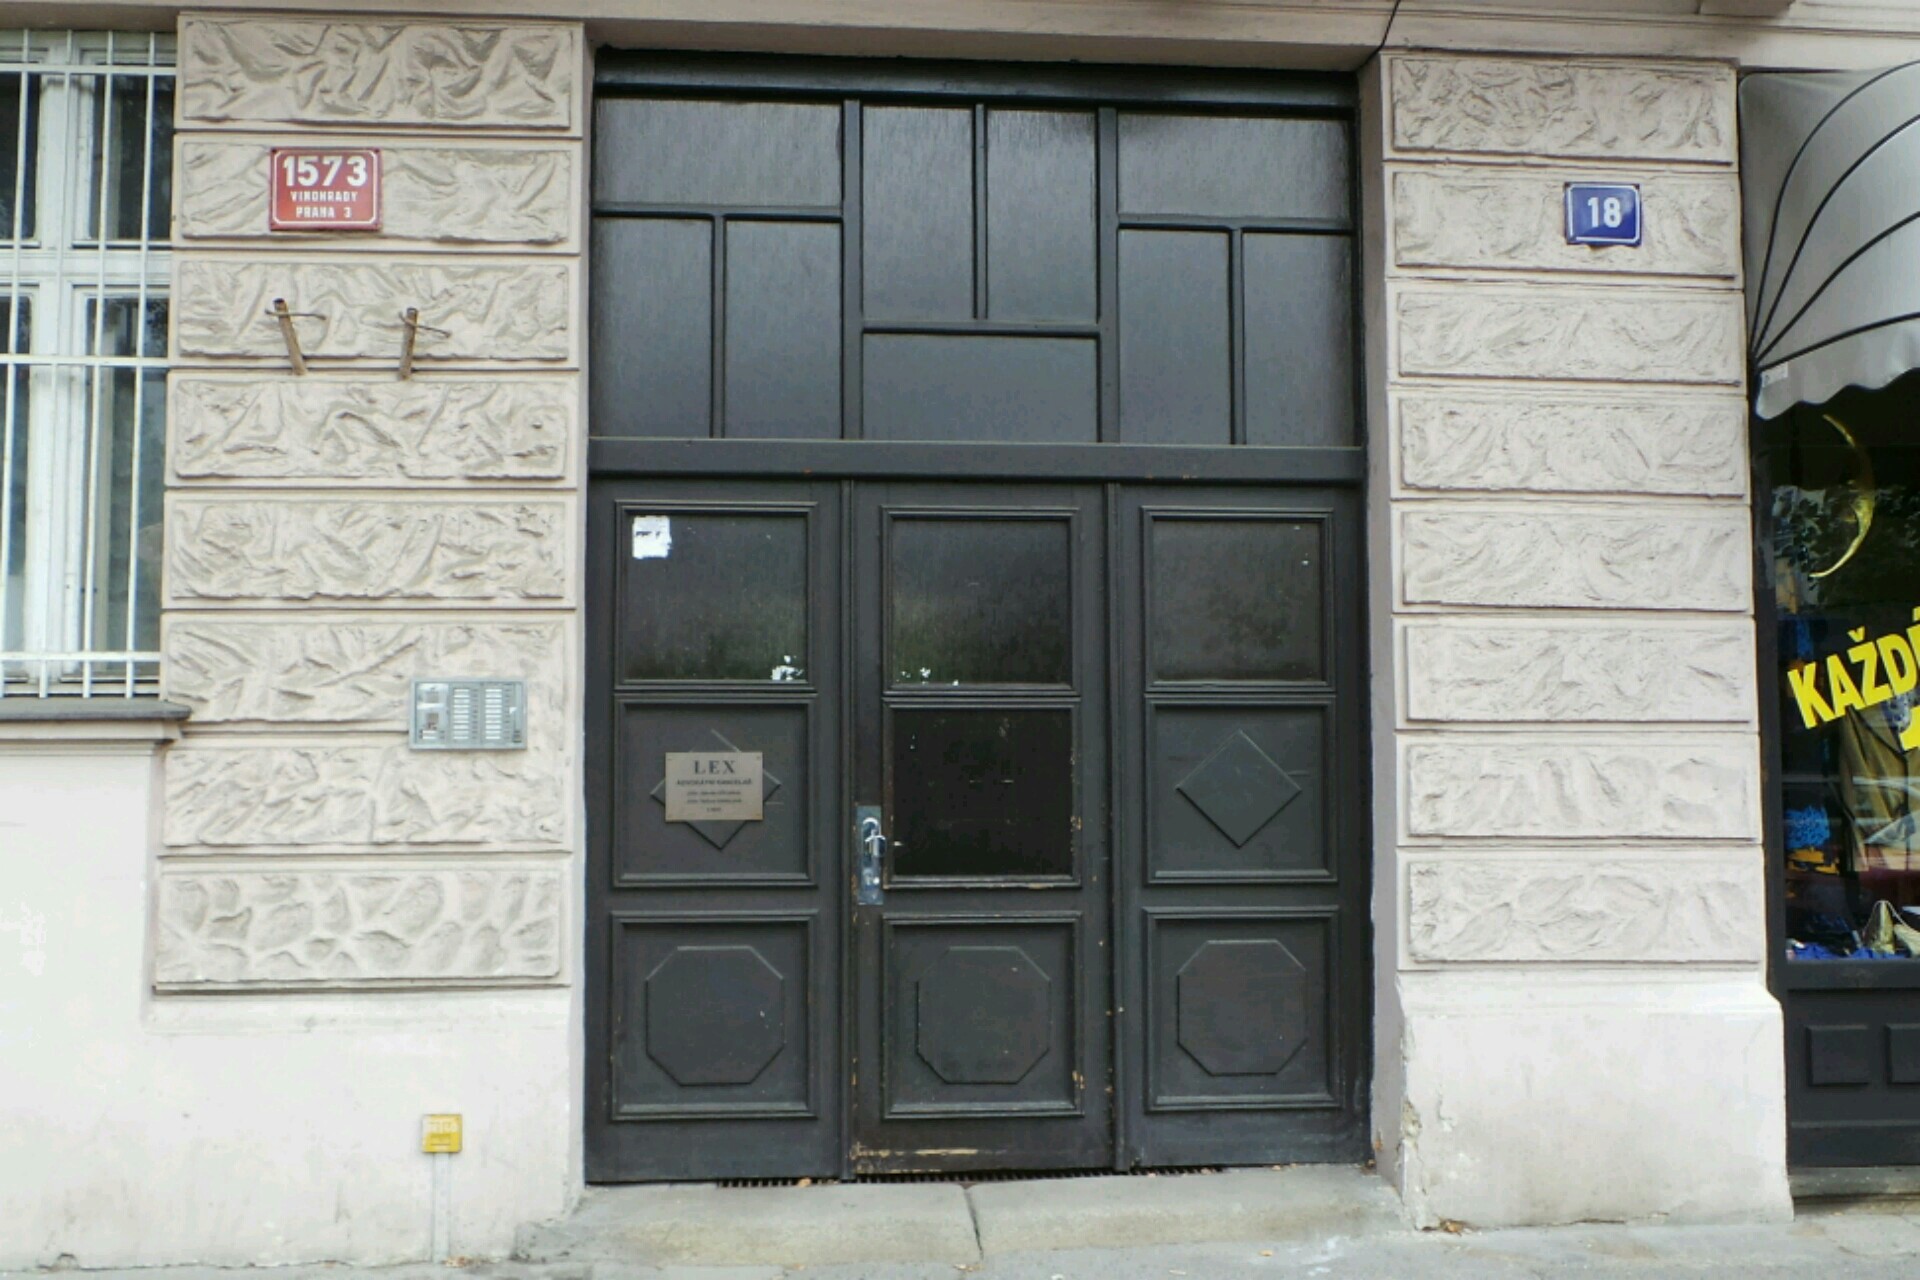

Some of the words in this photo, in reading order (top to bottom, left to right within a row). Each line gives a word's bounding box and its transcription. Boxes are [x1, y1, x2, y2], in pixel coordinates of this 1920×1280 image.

[283, 155, 367, 187] 1573
[290, 191, 358, 202] VINOHRADY
[296, 206, 336, 218] PRAHA
[344, 206, 352, 218] 3
[1587, 197, 1622, 228] 18
[694, 760, 736, 775] LEX
